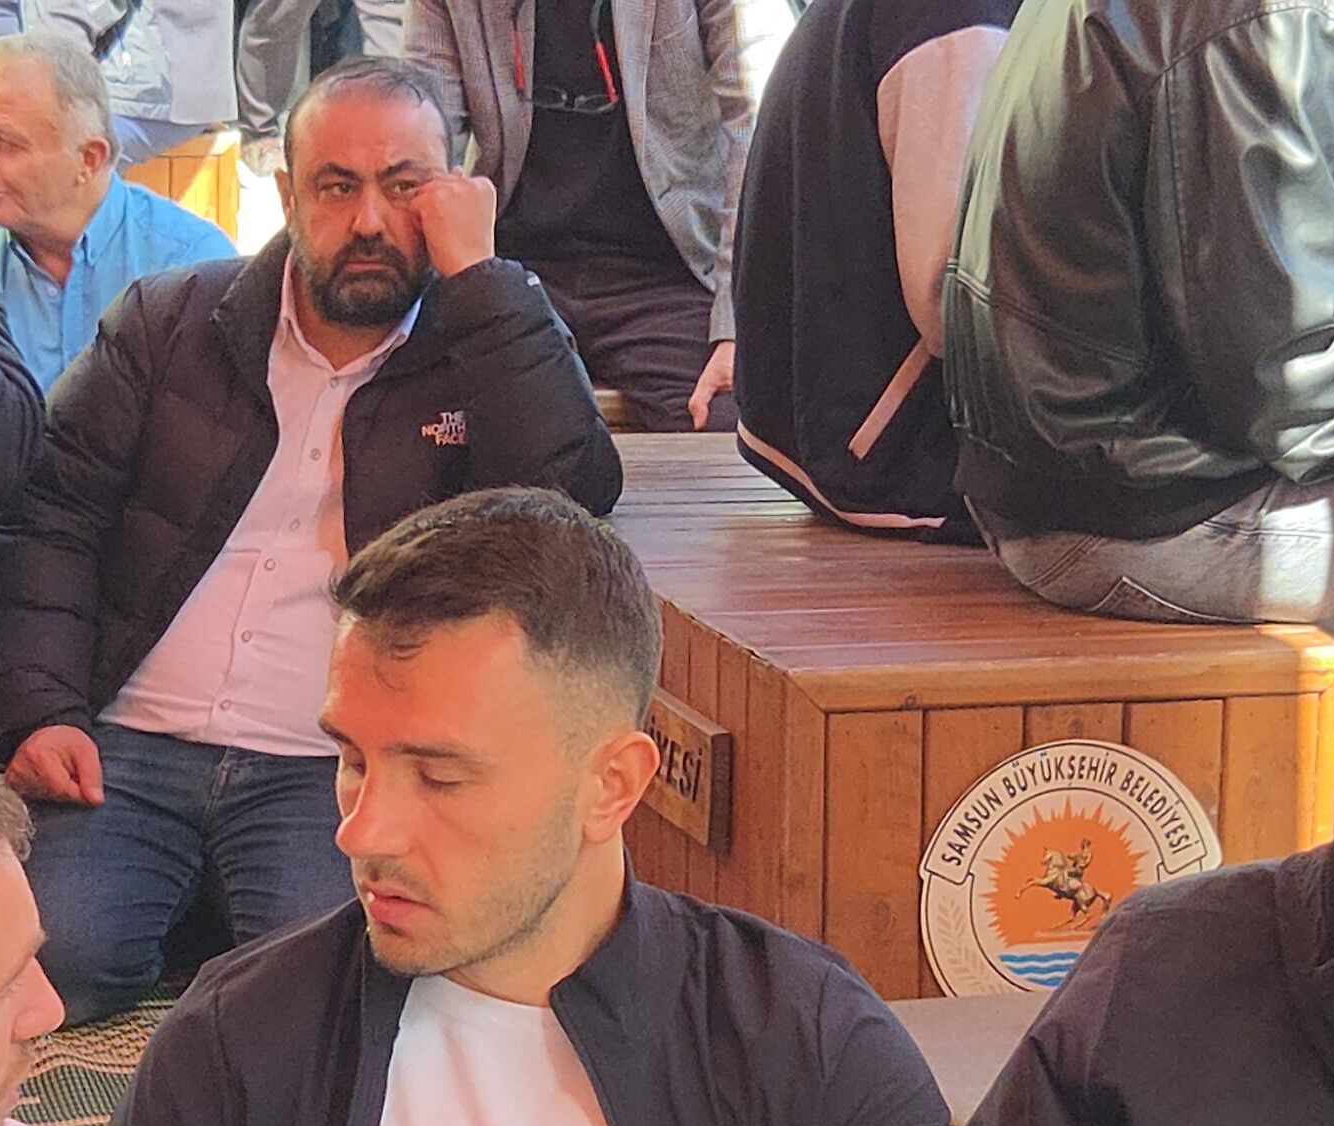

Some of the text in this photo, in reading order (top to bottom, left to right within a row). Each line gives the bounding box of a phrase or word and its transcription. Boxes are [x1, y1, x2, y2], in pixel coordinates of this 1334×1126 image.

[439, 410, 466, 424] THE
[421, 421, 466, 437] NORTH
[941, 751, 1202, 867] SAMSUN BÜYÜKŞEHİR BELEDİYESİ
